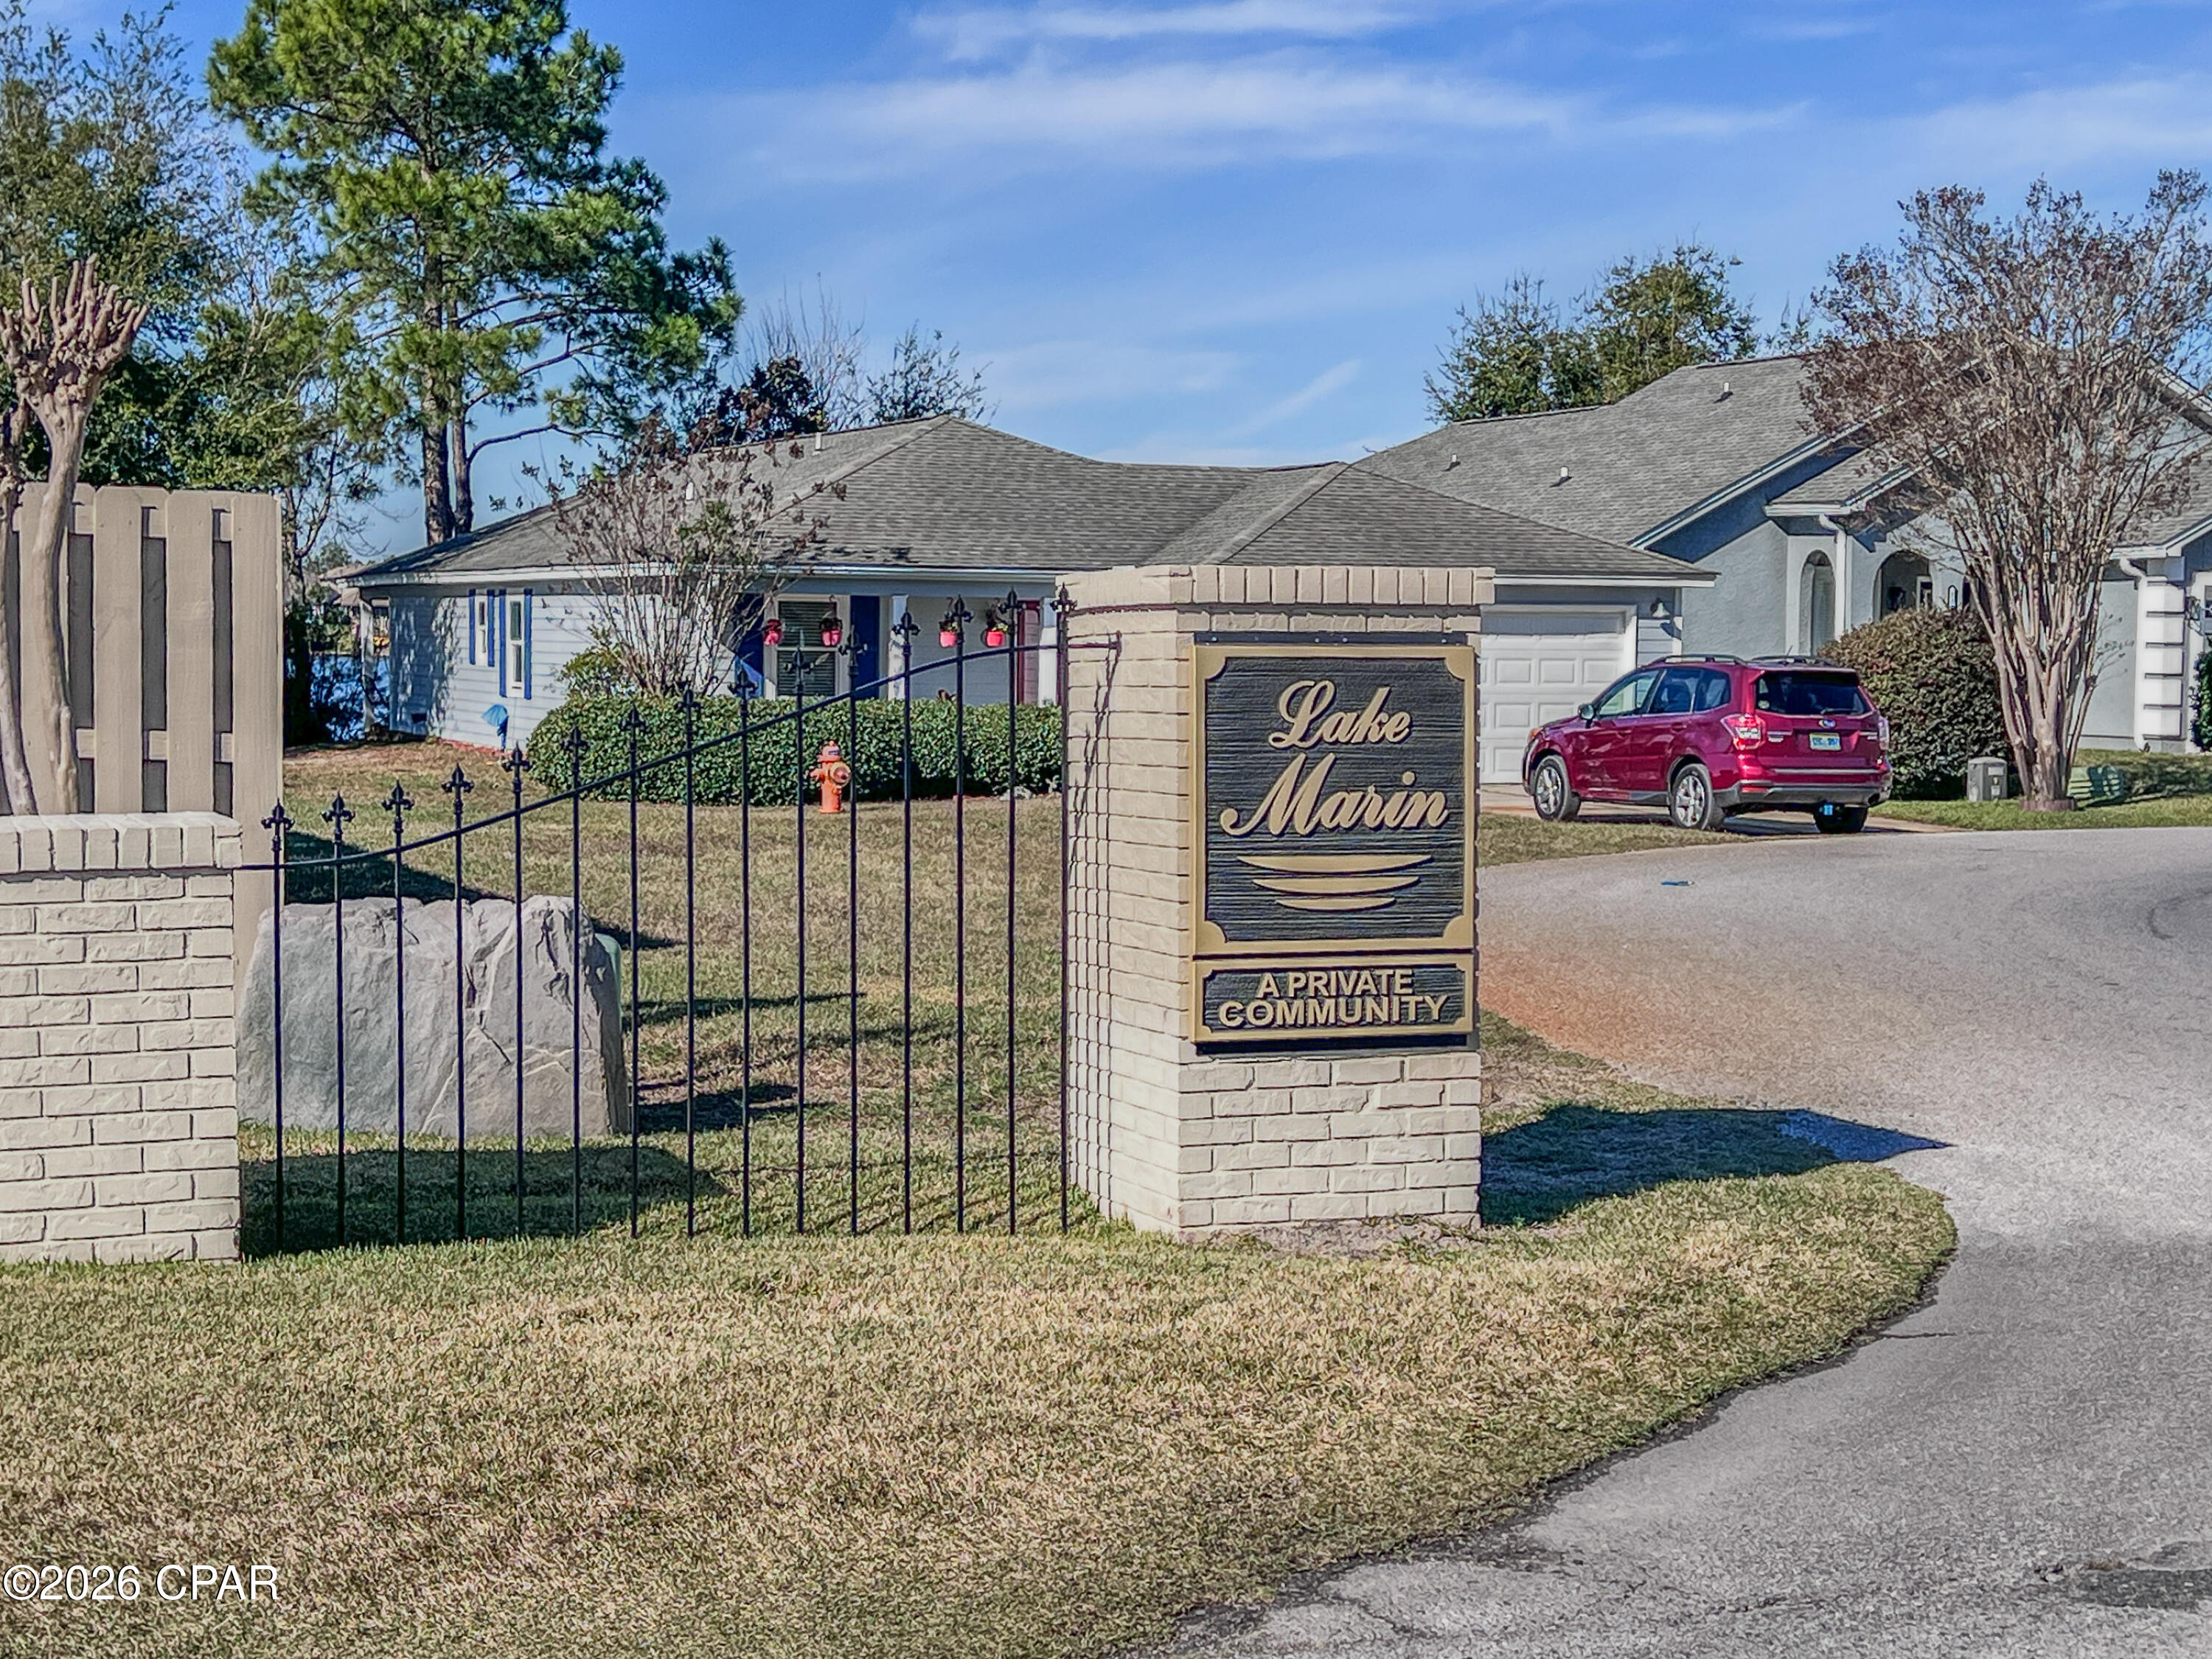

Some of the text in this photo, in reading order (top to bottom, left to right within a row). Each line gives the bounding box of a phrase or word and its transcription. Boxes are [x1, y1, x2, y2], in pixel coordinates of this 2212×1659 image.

[1268, 679, 1411, 748] Lake
[1219, 752, 1449, 836] Marin
[1256, 969, 1413, 998] A PRIVATE
[1219, 995, 1447, 1027] COMMUNITY
